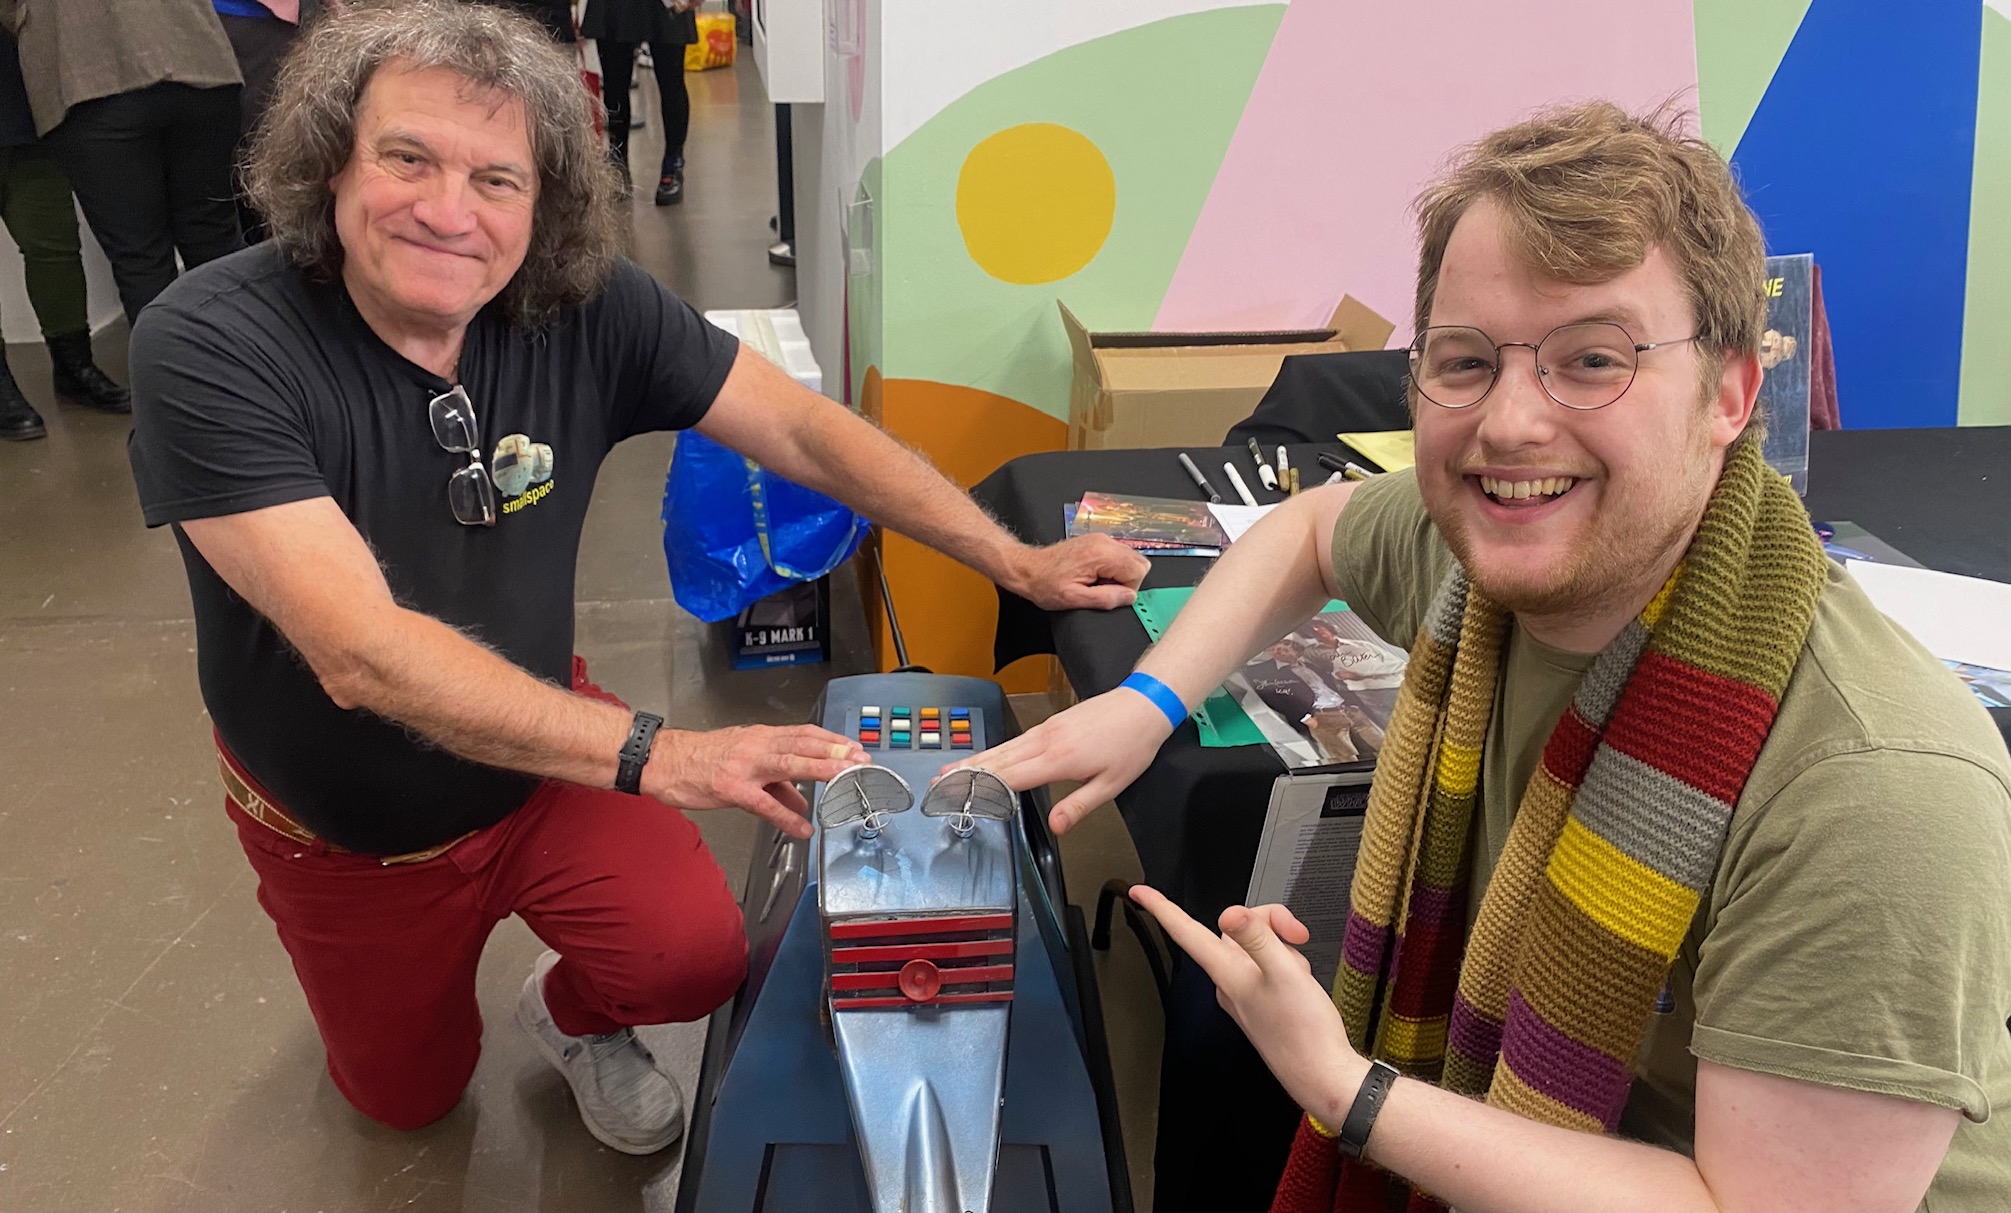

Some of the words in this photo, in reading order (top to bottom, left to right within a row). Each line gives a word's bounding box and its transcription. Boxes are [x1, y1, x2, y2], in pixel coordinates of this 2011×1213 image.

[1762, 277, 1785, 298] NE
[502, 479, 554, 514] smallspace
[745, 631, 766, 646] K-9
[771, 627, 804, 644] MARK
[808, 626, 813, 640] 1
